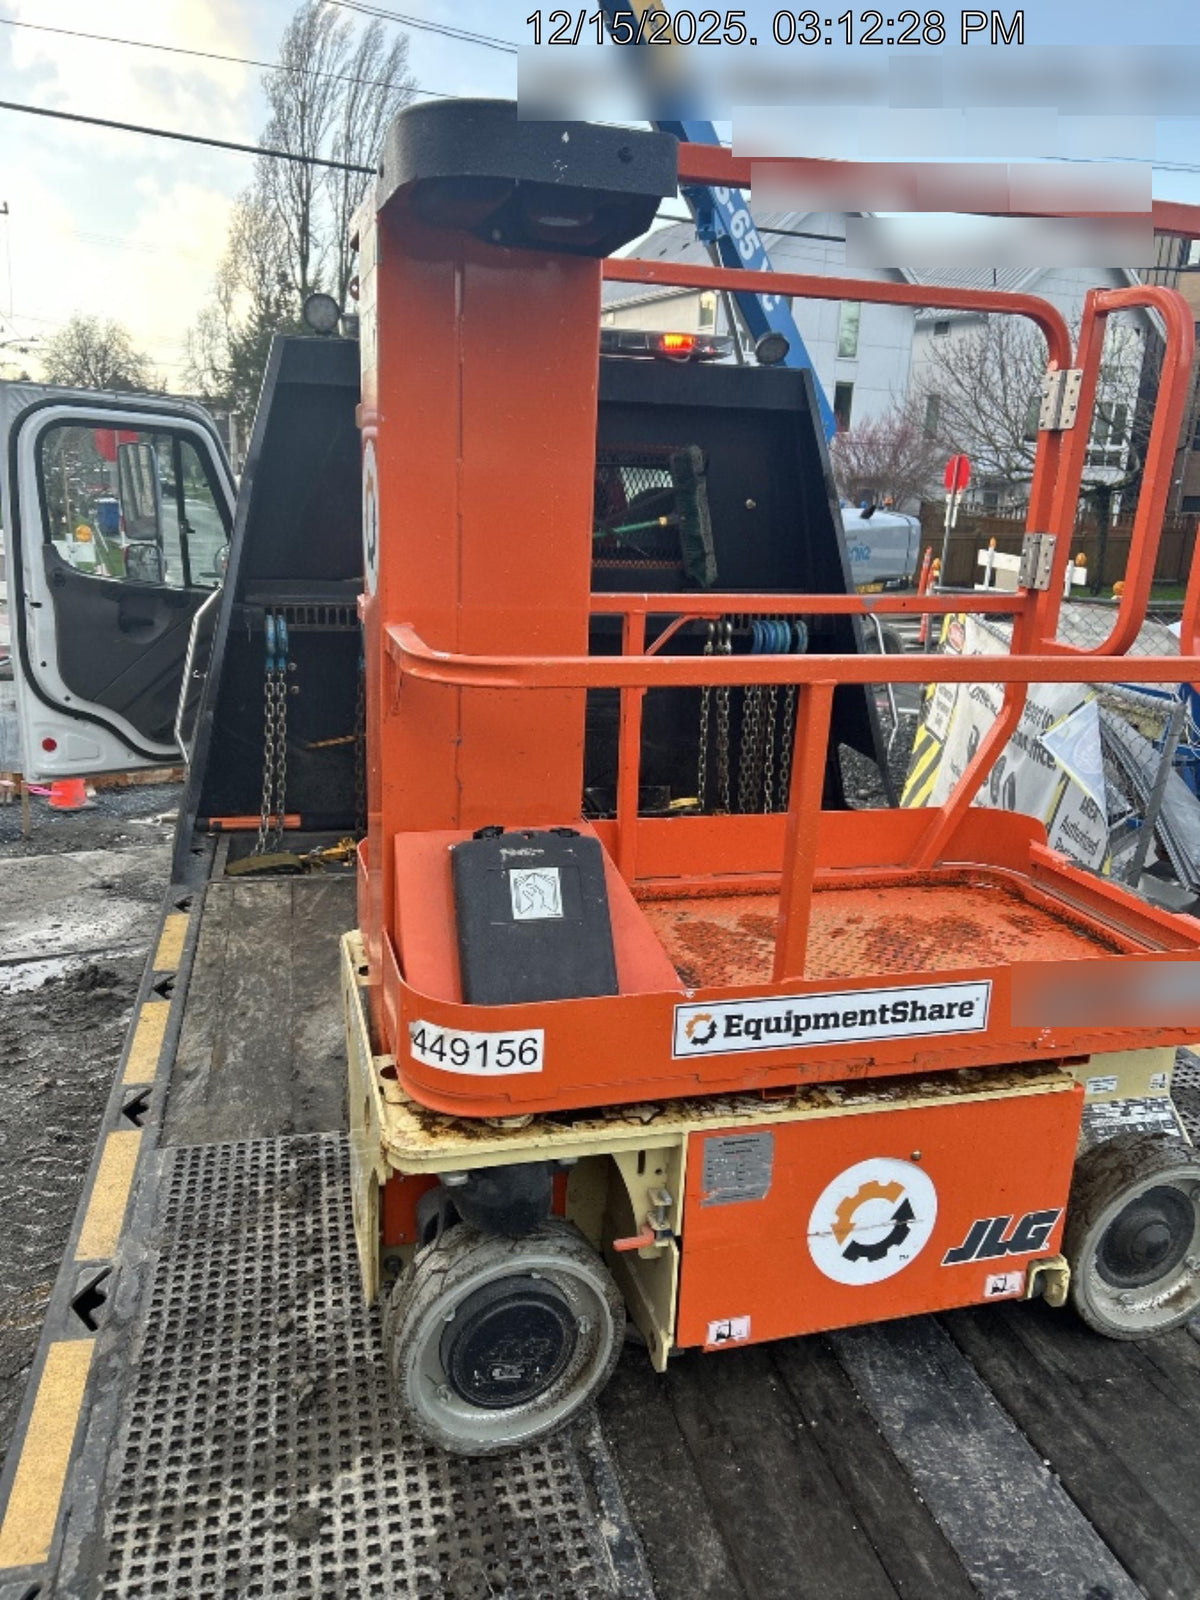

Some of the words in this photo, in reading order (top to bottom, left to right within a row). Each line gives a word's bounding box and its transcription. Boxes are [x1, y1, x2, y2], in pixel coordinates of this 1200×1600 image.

[723, 998, 976, 1041] EquipmentShare
[412, 1028, 538, 1068] 449156
[940, 1208, 1063, 1266] JLG
